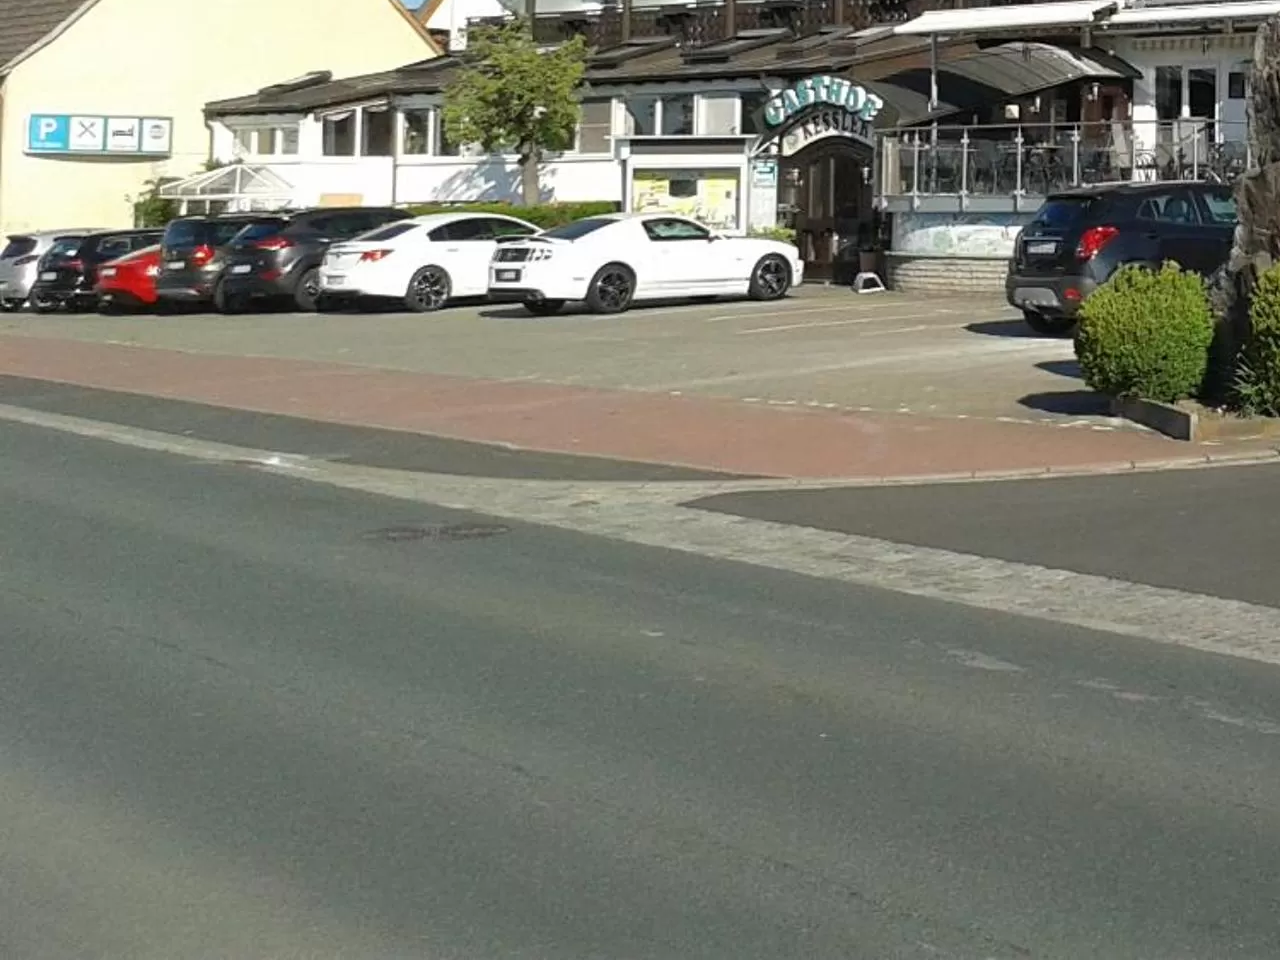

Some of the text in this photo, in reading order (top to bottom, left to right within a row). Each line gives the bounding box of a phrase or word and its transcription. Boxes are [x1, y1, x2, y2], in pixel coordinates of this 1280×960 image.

[764, 75, 884, 126] GASTHOF
[39, 117, 58, 141] P
[800, 110, 870, 141] KESSLER
